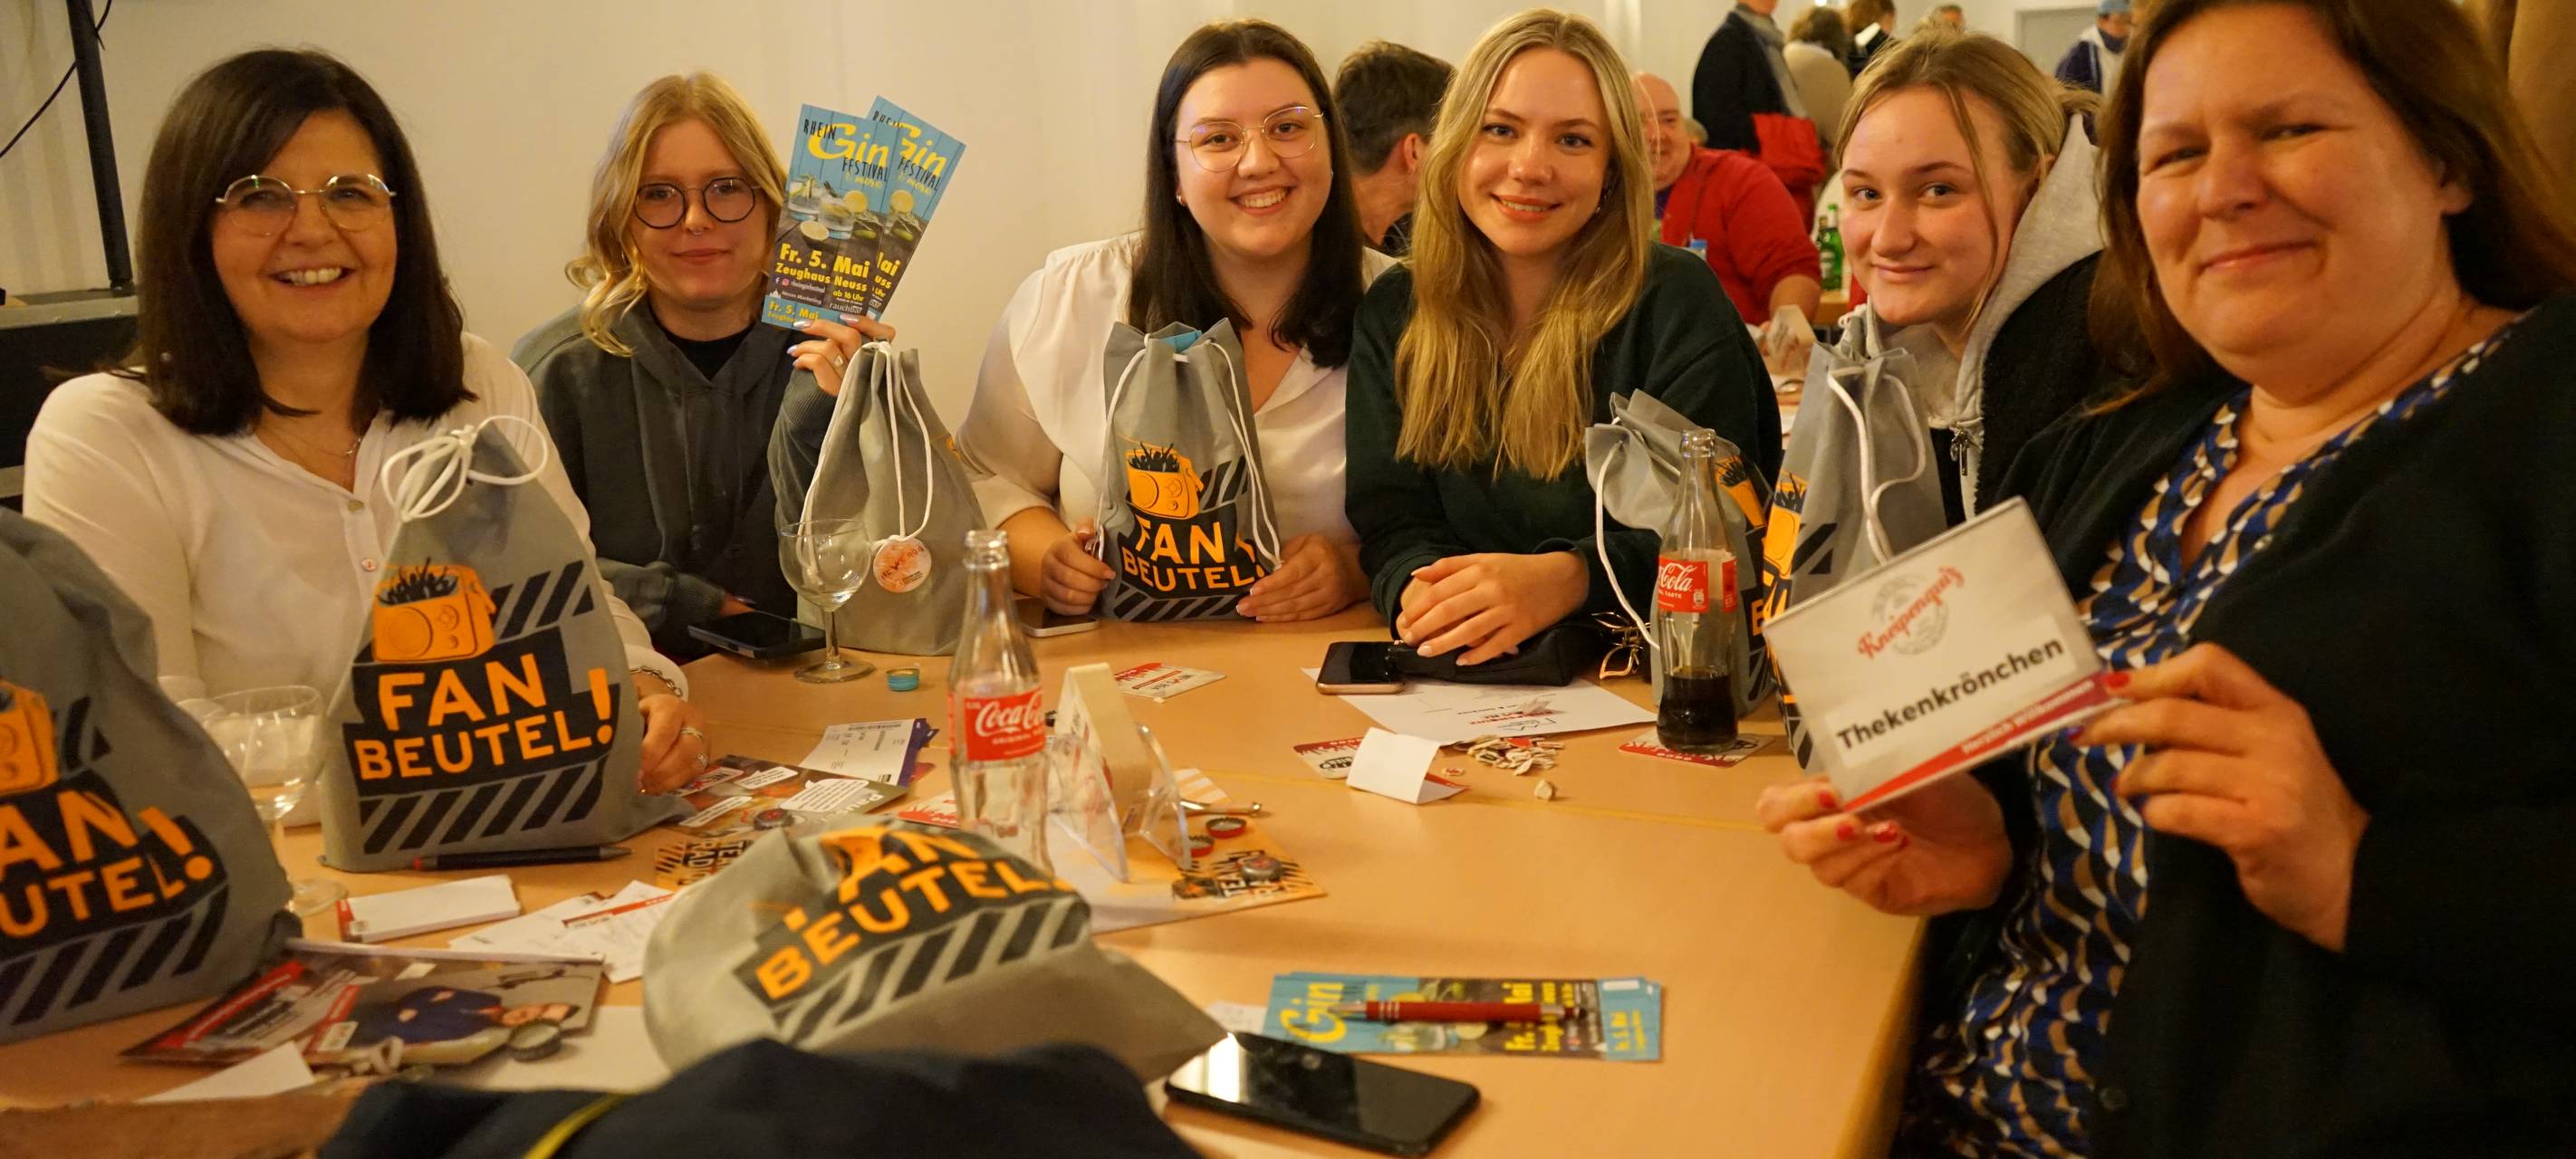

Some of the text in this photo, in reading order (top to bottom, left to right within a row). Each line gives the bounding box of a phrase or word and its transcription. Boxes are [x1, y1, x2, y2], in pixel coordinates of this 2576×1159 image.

[803, 119, 837, 140] RHEIN
[807, 122, 889, 168] Gin
[775, 263, 868, 292] Zeughaus Neuss
[780, 243, 870, 278] Fr. 5. Mai
[874, 274, 892, 290] uss
[1134, 513, 1226, 565] FAN
[377, 653, 547, 732] FAN
[1836, 638, 2064, 750] Thekenkrönchen
[353, 667, 614, 781] BEUTEL!
[0, 789, 138, 880] AN
[0, 806, 214, 939] UTEL!
[1279, 982, 1348, 1043] Gin
